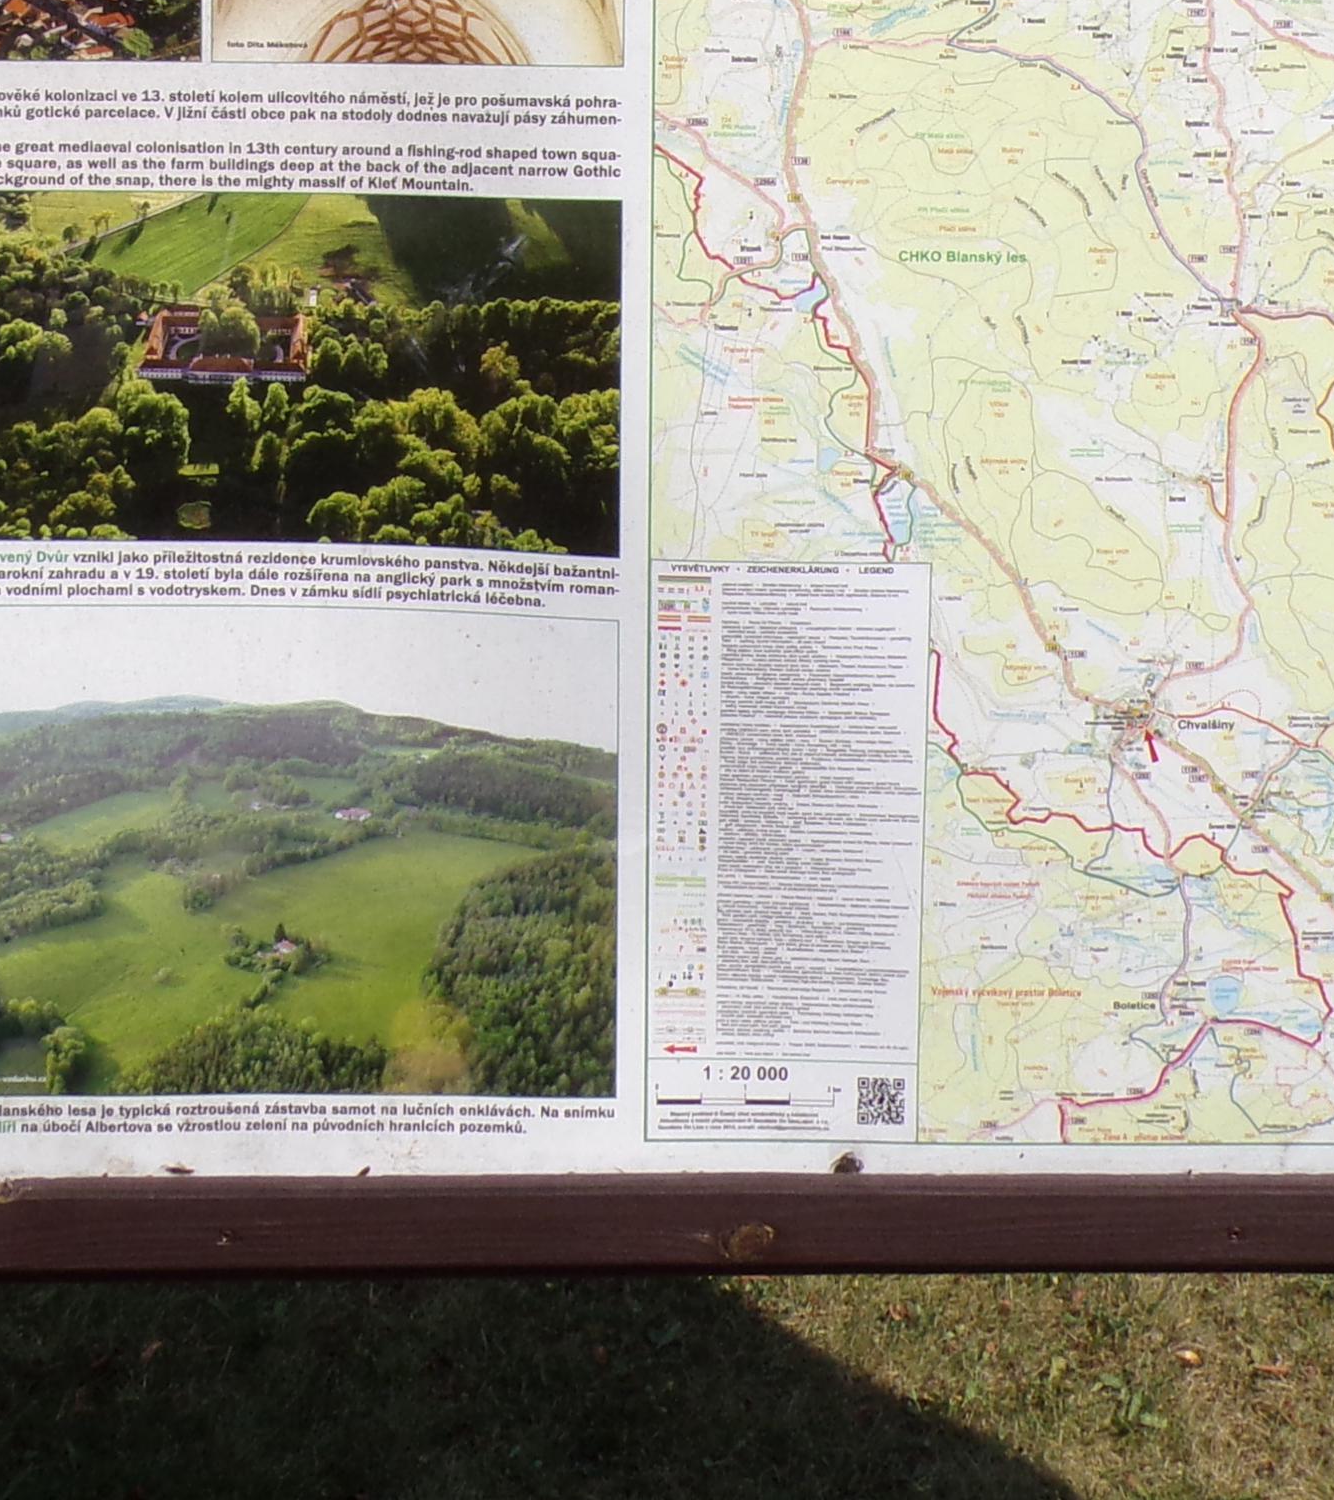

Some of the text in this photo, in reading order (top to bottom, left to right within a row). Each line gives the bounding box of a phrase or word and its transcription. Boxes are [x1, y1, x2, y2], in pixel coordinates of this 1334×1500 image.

[897, 250, 1027, 265] CHKO Blanský les
[671, 563, 894, 575] VYSVĚTLIVKY ZEICHENERKLÄRUNG LEGEND
[1178, 719, 1235, 733] Chvalšiny
[1113, 1001, 1155, 1010] Boletice
[703, 1066, 711, 1081] 1
[730, 1066, 750, 1081] 20
[757, 1066, 789, 1081] 000
